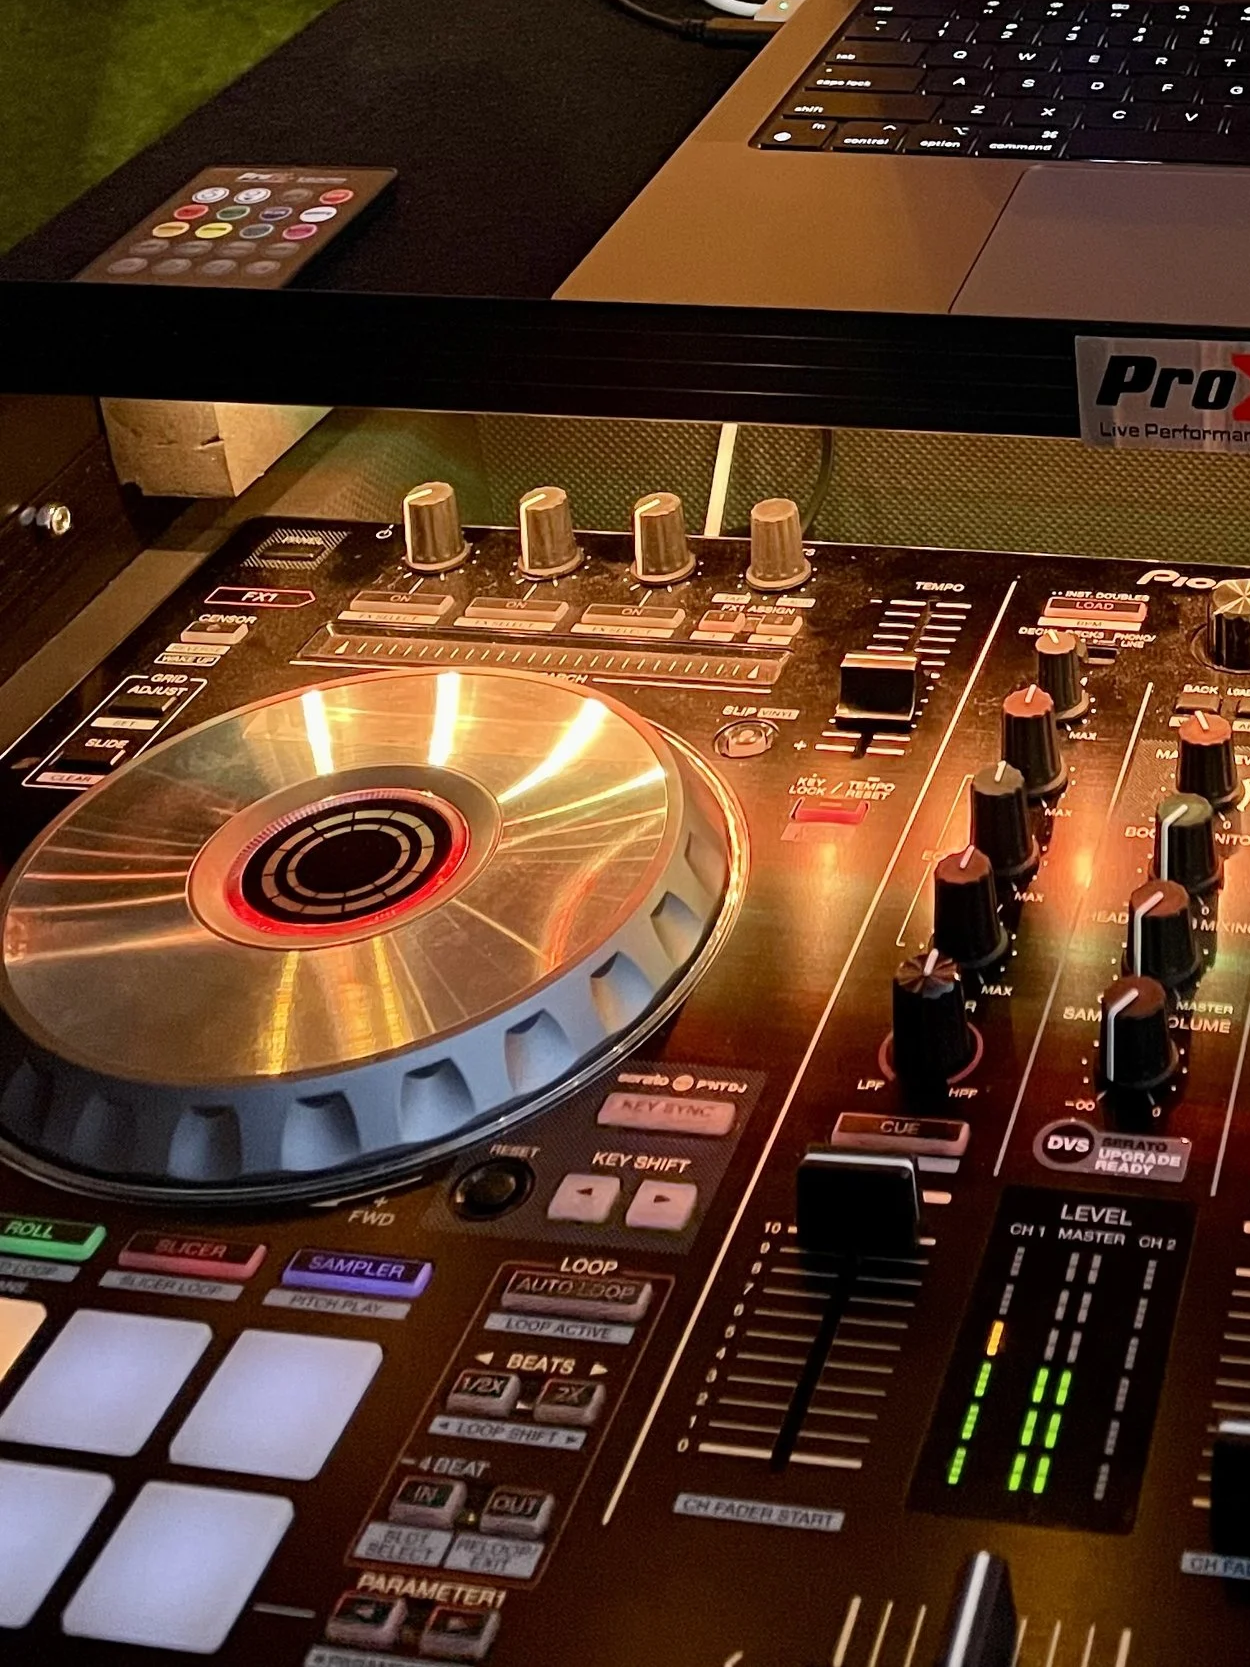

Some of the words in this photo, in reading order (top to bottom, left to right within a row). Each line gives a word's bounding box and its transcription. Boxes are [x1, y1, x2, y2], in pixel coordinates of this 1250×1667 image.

[953, 50, 968, 59] Q
[1018, 52, 1036, 61] W
[816, 78, 844, 88] caps
[846, 78, 871, 88] lock
[953, 77, 966, 86] A
[1022, 78, 1036, 88] S
[794, 105, 824, 113] shift
[1041, 107, 1056, 116] X
[1112, 110, 1126, 119] C
[1185, 112, 1198, 122] V
[843, 137, 889, 145] control
[920, 139, 961, 149] option
[989, 141, 1052, 152] command
[1099, 422, 1140, 438] Live
[915, 581, 965, 593] TEMPO
[240, 591, 278, 603] FX1
[391, 593, 412, 604] ON
[506, 599, 528, 610] ON
[1075, 601, 1115, 610] LOAD
[622, 606, 645, 617] ON
[198, 613, 257, 625] CENSOR
[161, 654, 193, 665] WAKE
[150, 673, 189, 684] GRID
[127, 684, 188, 697] ADJUST
[1183, 685, 1219, 695] BACK
[722, 706, 756, 717] SLIP
[1069, 731, 1097, 741] MAX
[85, 738, 129, 750] SLIDE
[797, 777, 826, 787] KEY
[849, 781, 895, 792] TEMPO
[789, 786, 826, 797] LOCK
[1045, 807, 1072, 817] MAX
[1014, 891, 1044, 903] MAX
[981, 985, 1012, 997] MAX
[1176, 1001, 1233, 1014] MASTER
[857, 1079, 885, 1091] LPF
[948, 1087, 978, 1099] HPF
[622, 1099, 660, 1113] KEY
[663, 1102, 717, 1118] SYNC
[880, 1120, 920, 1134] CUE
[1047, 1135, 1090, 1153] DVS
[1101, 1137, 1168, 1152] SERATO
[490, 1144, 541, 1159] RESET
[592, 1151, 632, 1168] KEY
[634, 1156, 692, 1174] SHIFT
[1098, 1149, 1182, 1168] UPGRADE
[1095, 1160, 1153, 1176] READY
[348, 1209, 397, 1228] FWD
[1060, 1203, 1133, 1227] LEVEL
[4, 1220, 53, 1239] ROLL
[1010, 1222, 1034, 1237] CH
[1058, 1227, 1126, 1245] MASTER
[155, 1239, 227, 1258] SLICER
[1139, 1236, 1163, 1250] CH
[308, 1255, 407, 1280] SAMPLER
[560, 1257, 618, 1276] LOOP
[177, 1280, 224, 1297] LOOP
[515, 1279, 573, 1297] AUTO
[577, 1283, 635, 1301] LOOP
[290, 1294, 339, 1311] PITCH
[340, 1300, 384, 1315] PLAY
[505, 1318, 550, 1332] LOOP
[553, 1321, 612, 1338] ACTIVE
[507, 1353, 576, 1375] BEATS
[507, 1425, 558, 1444] SHIFT
[682, 1497, 711, 1513] CH
[714, 1501, 773, 1521] FADER
[777, 1508, 836, 1529] START
[1190, 1556, 1219, 1573] CH
